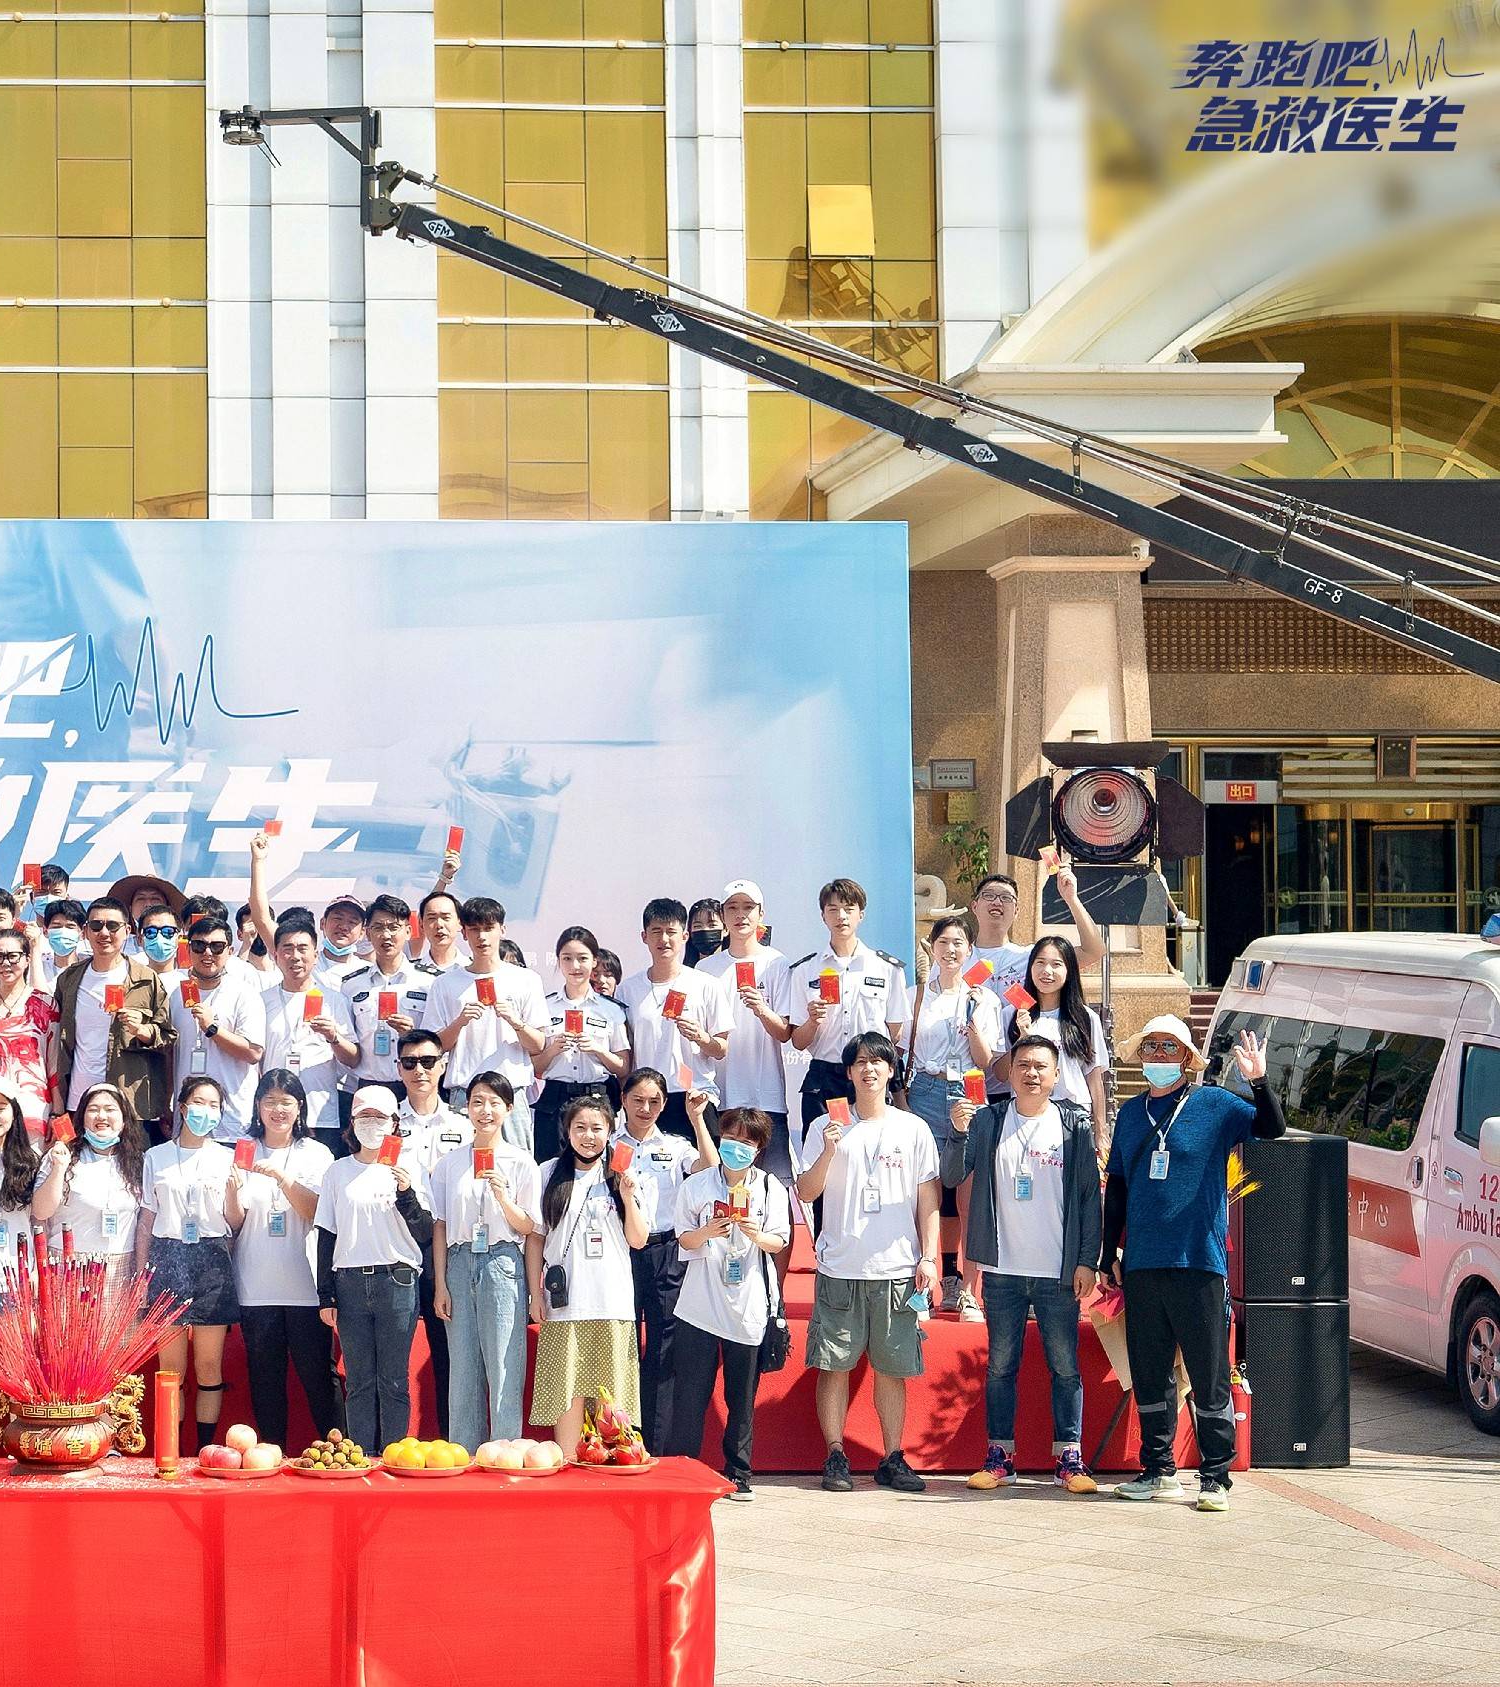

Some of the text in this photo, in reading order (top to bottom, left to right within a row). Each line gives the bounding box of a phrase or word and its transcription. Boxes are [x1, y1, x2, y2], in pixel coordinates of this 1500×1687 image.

[428, 221, 451, 236] GFM
[1304, 578, 1344, 604] GF-8
[1230, 784, 1252, 797] 出口
